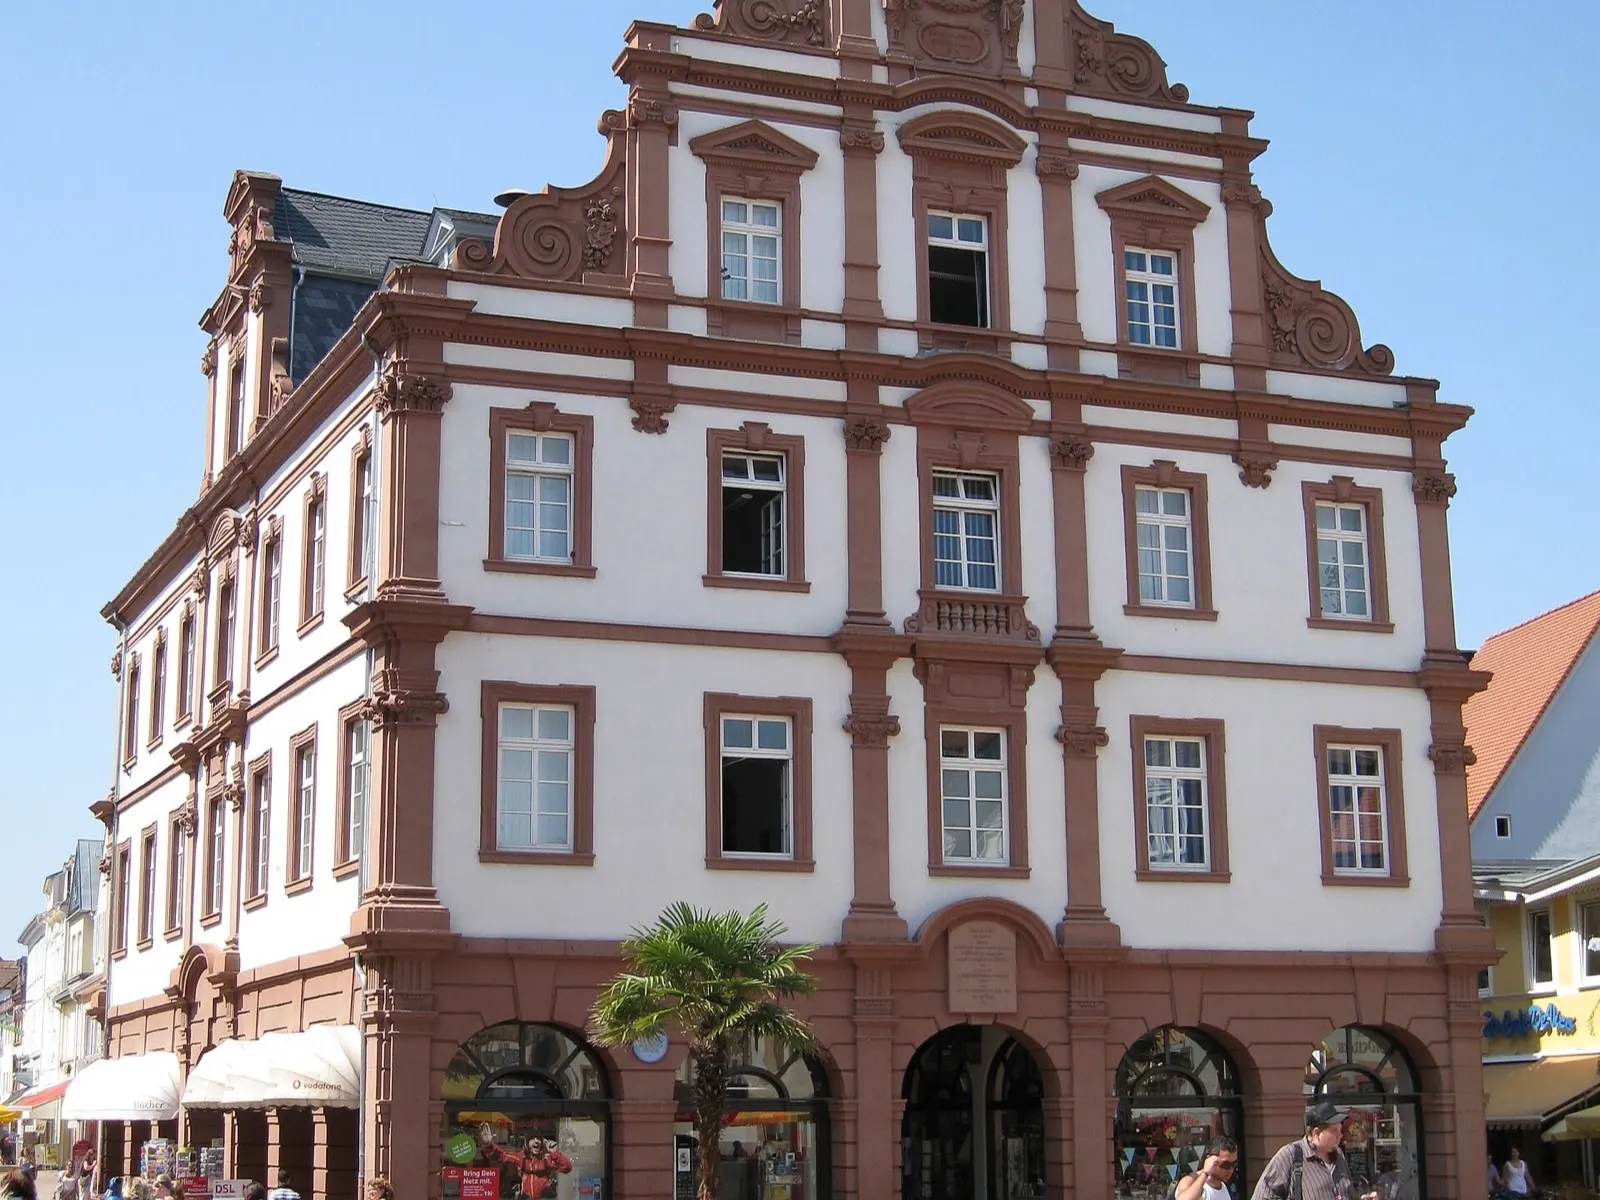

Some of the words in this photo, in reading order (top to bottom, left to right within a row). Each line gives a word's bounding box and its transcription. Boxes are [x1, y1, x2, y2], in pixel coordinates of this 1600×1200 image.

[303, 1083, 342, 1092] vodafone
[133, 1100, 165, 1109] Bücher
[463, 1170, 480, 1178] Bring
[215, 1184, 236, 1194] DSL
